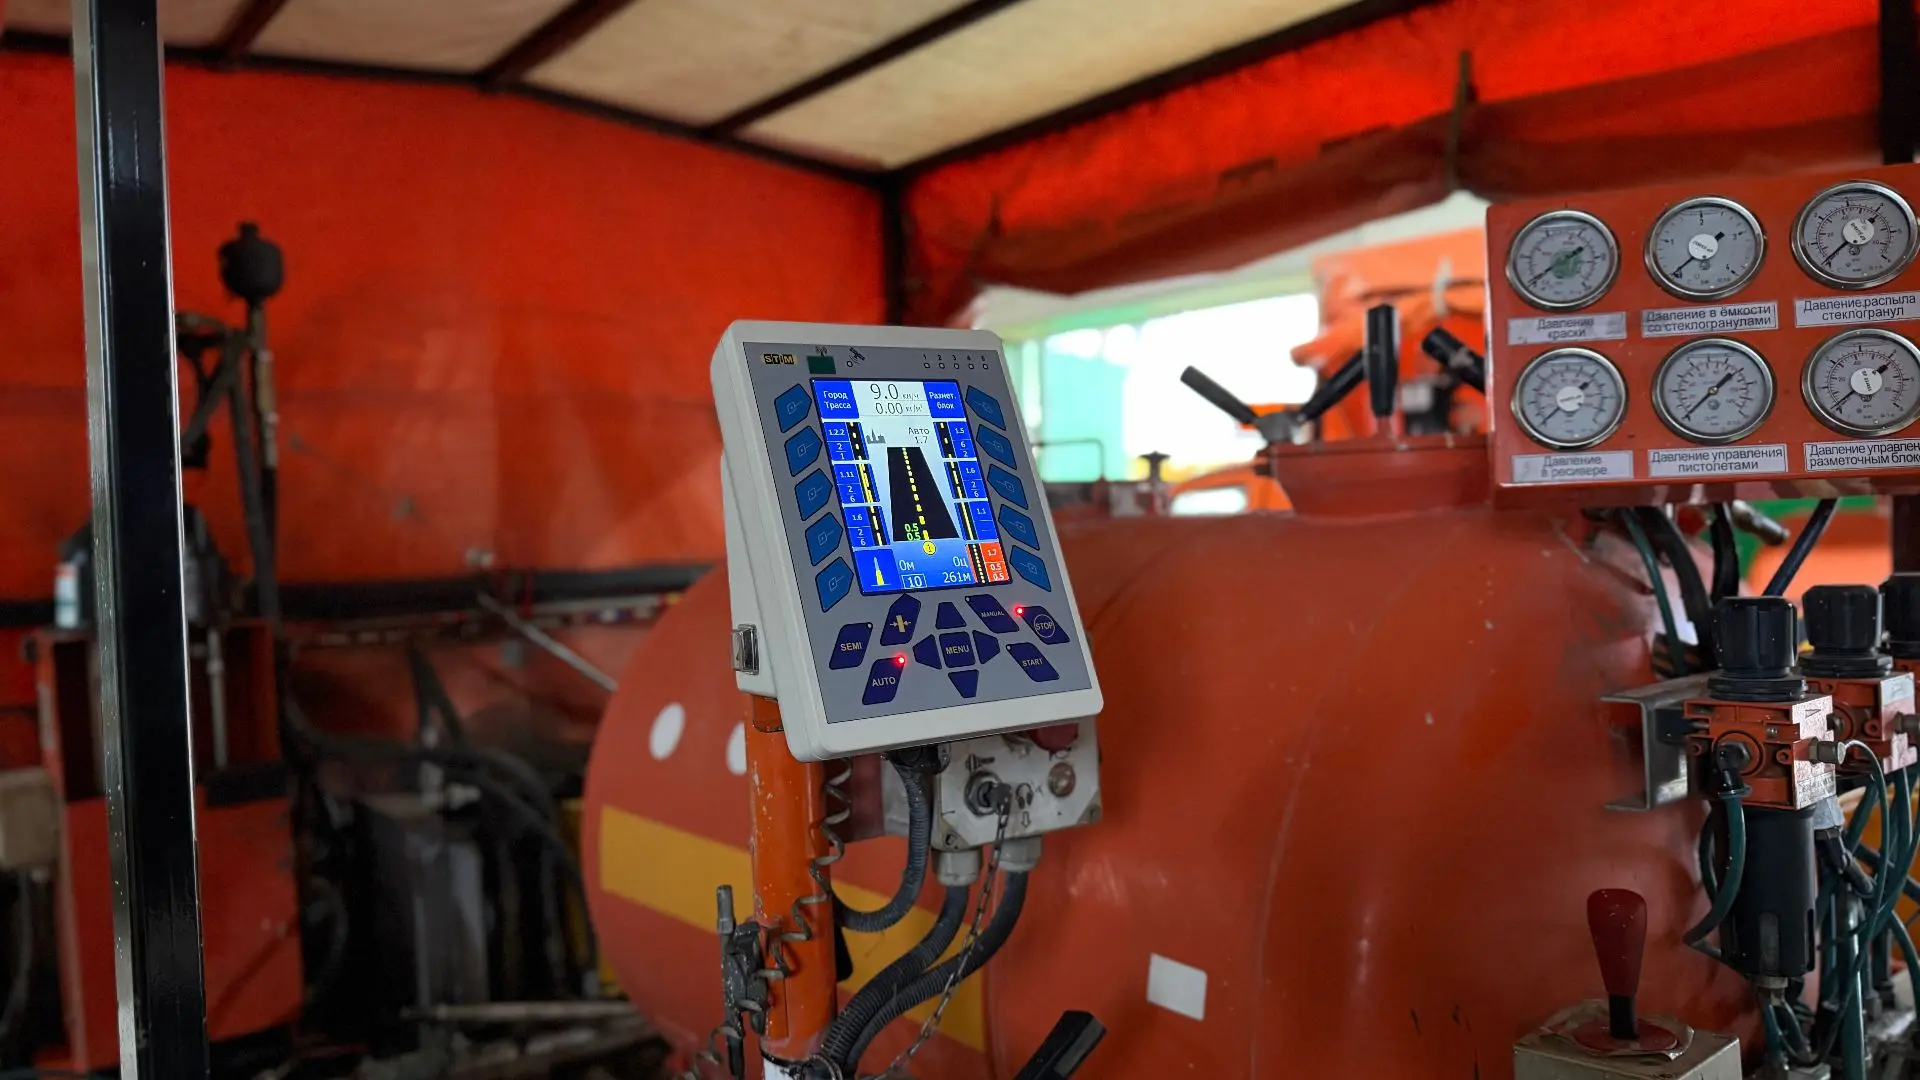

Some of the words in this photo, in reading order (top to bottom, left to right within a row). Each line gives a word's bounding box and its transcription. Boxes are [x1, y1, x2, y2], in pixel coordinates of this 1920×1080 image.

[1699, 218, 1705, 226] 2
[1803, 299, 1862, 313] Давление
[1864, 294, 1916, 307] распыла
[1646, 310, 1706, 323] Давление
[1709, 309, 1717, 318] в
[1720, 304, 1771, 317] ёмкости
[1822, 307, 1904, 321] стеклогранул
[1537, 318, 1594, 330] Давление
[1647, 324, 1662, 332] со
[1664, 317, 1771, 332] стеклогранулами
[1548, 329, 1586, 340] краски
[823, 390, 849, 401] Город
[870, 383, 899, 400] 9.0
[823, 401, 852, 411] Трасса
[875, 402, 904, 415] 0.00
[937, 401, 955, 410] блок
[908, 427, 930, 435] Авто
[914, 436, 928, 444] 1.7
[1810, 444, 1866, 457] Давление
[1867, 442, 1920, 456] управлен
[1542, 455, 1602, 468] Давление
[1652, 451, 1710, 464] Давление
[1711, 448, 1783, 462] управления
[1810, 455, 1889, 469] разметочным
[1891, 452, 1920, 464] блок
[1678, 460, 1759, 473] пистолетами
[1551, 466, 1608, 479] ресивере
[976, 507, 987, 515] 1.1
[851, 513, 863, 521] 1.6
[904, 523, 919, 532] 0.5
[906, 532, 921, 541] 0.5
[989, 563, 1002, 571] 0.5
[907, 576, 922, 588] 10
[942, 571, 972, 584] 261м
[1035, 622, 1054, 631] STOP
[840, 642, 863, 652] SEMI
[945, 644, 970, 655] MENU
[1022, 658, 1043, 667] START
[871, 676, 897, 687] AUTO
